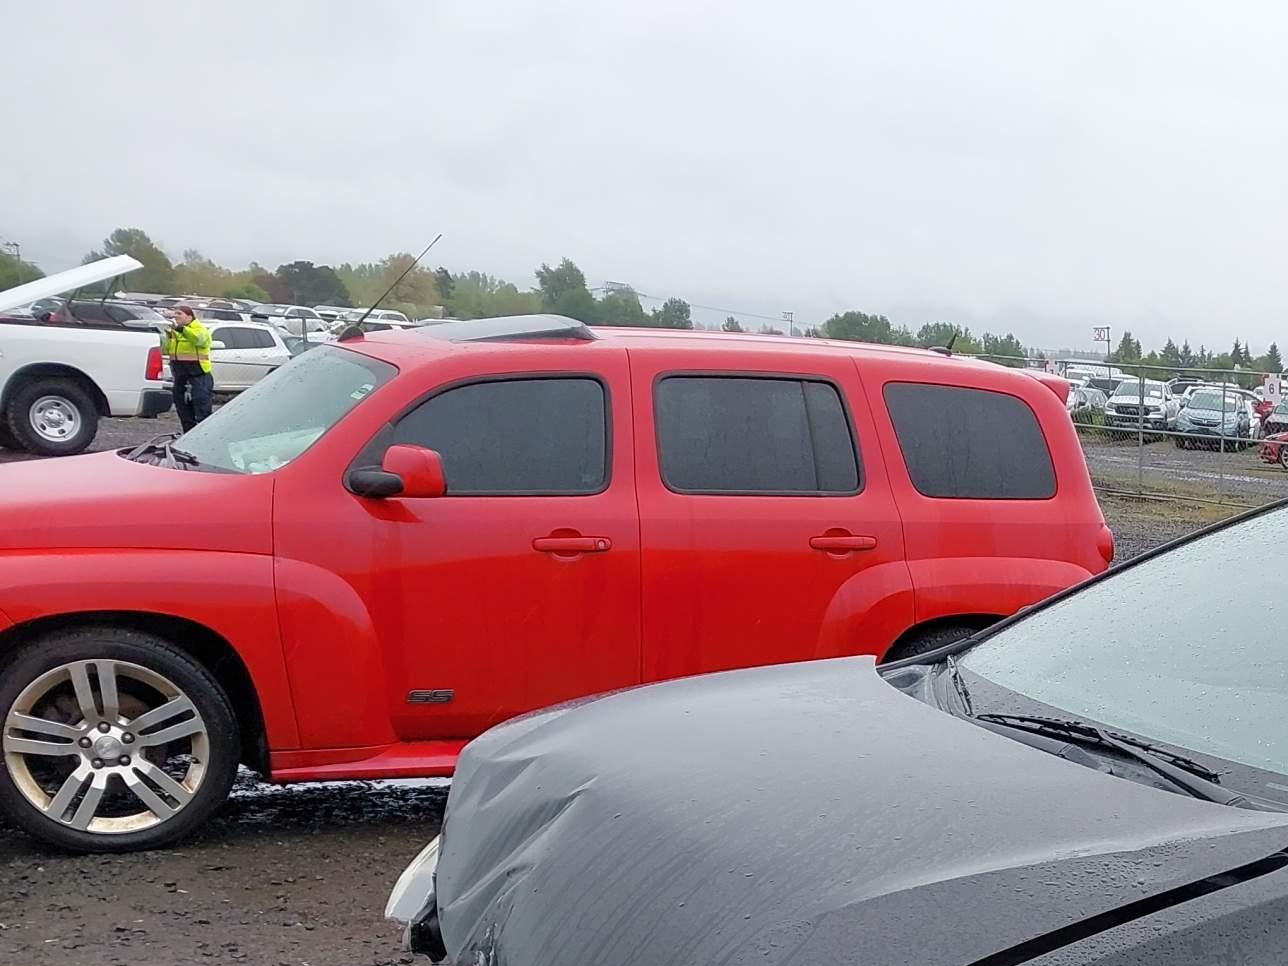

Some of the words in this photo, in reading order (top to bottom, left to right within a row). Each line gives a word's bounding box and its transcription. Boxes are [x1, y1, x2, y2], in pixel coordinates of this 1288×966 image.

[1094, 329, 1106, 341] 30
[1268, 383, 1275, 395] 6
[407, 689, 455, 704] SS
